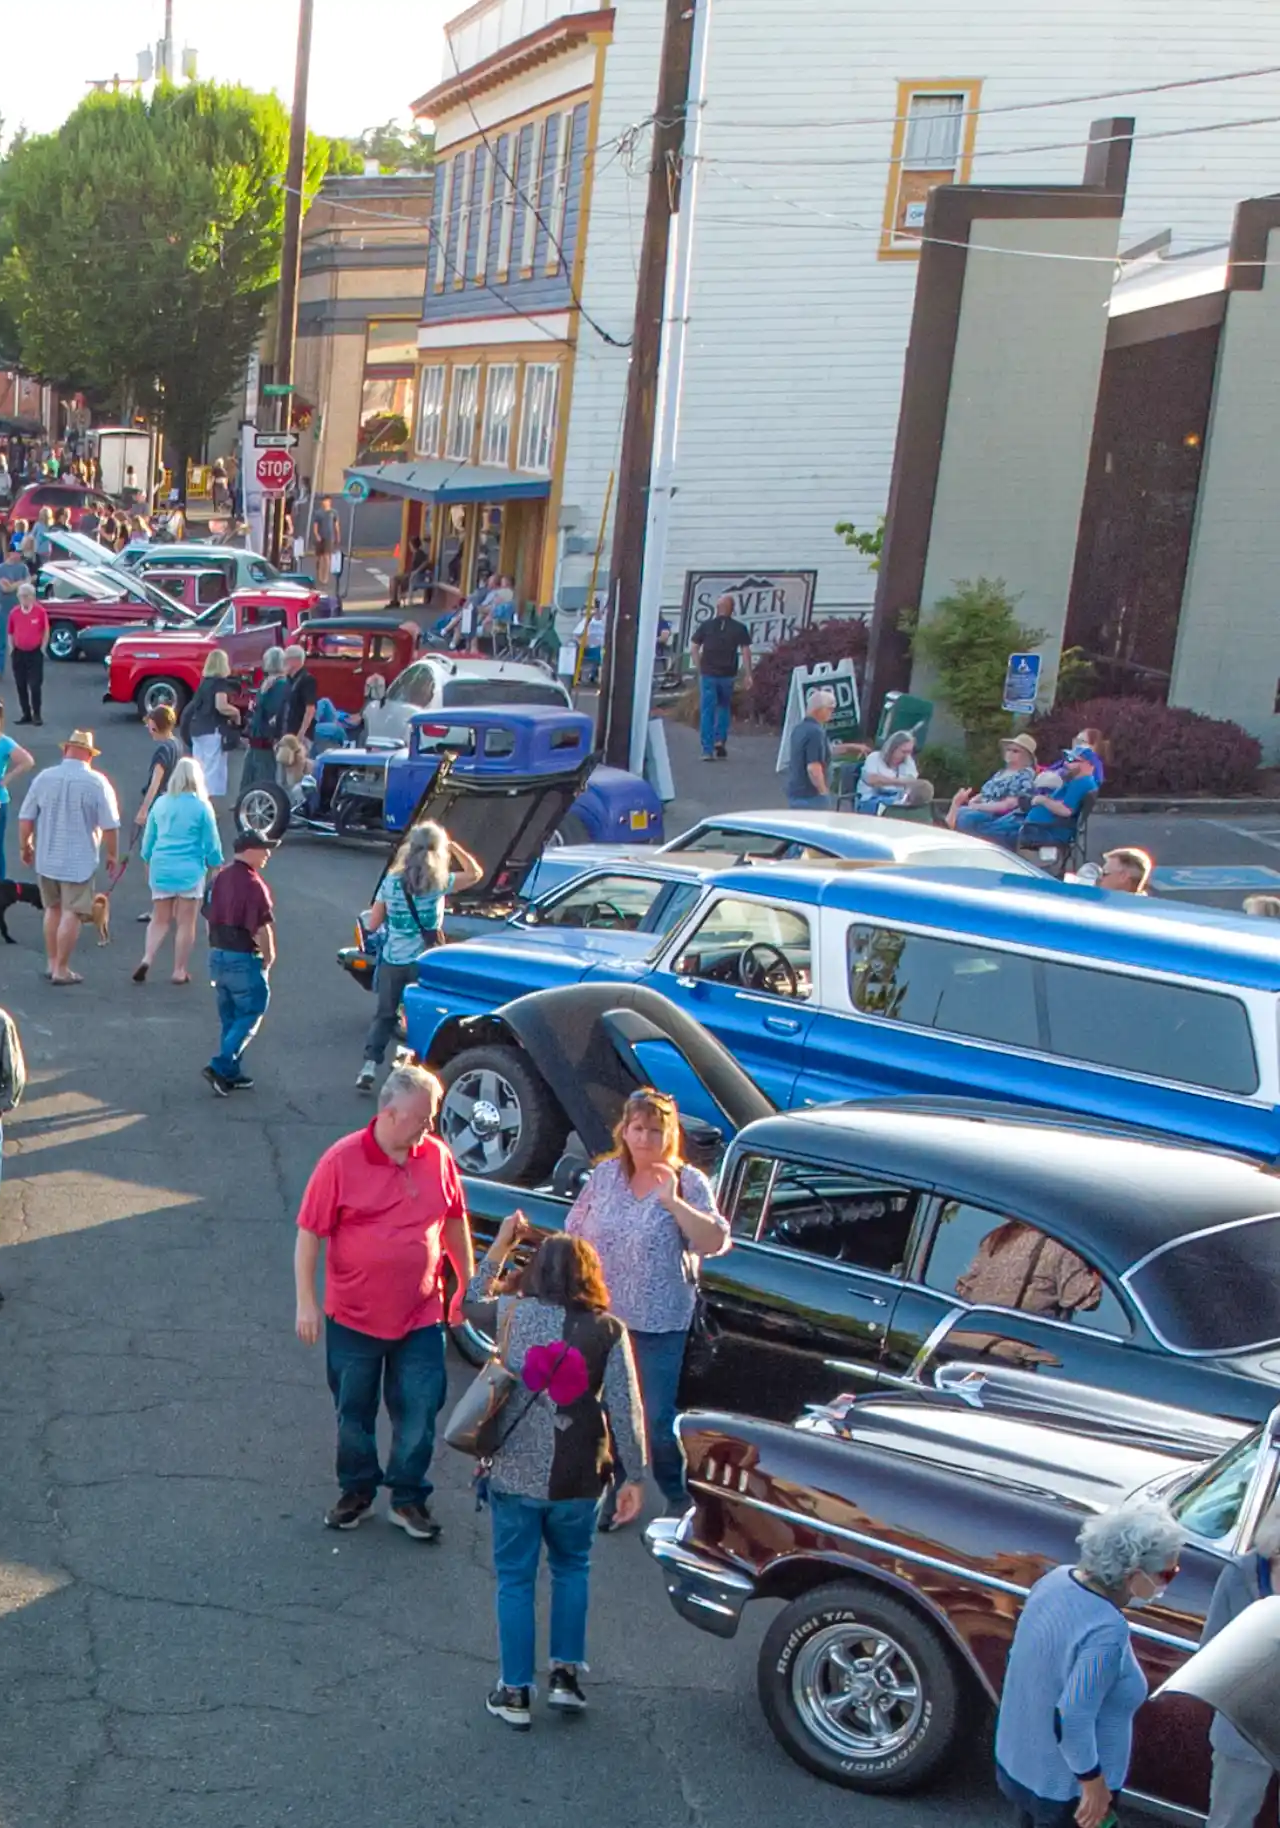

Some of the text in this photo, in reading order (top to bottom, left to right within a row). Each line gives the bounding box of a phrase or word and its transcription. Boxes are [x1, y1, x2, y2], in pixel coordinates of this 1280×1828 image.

[258, 460, 292, 477] STOP
[694, 588, 786, 623] SVER
[776, 1610, 856, 1675] Radial T/A
